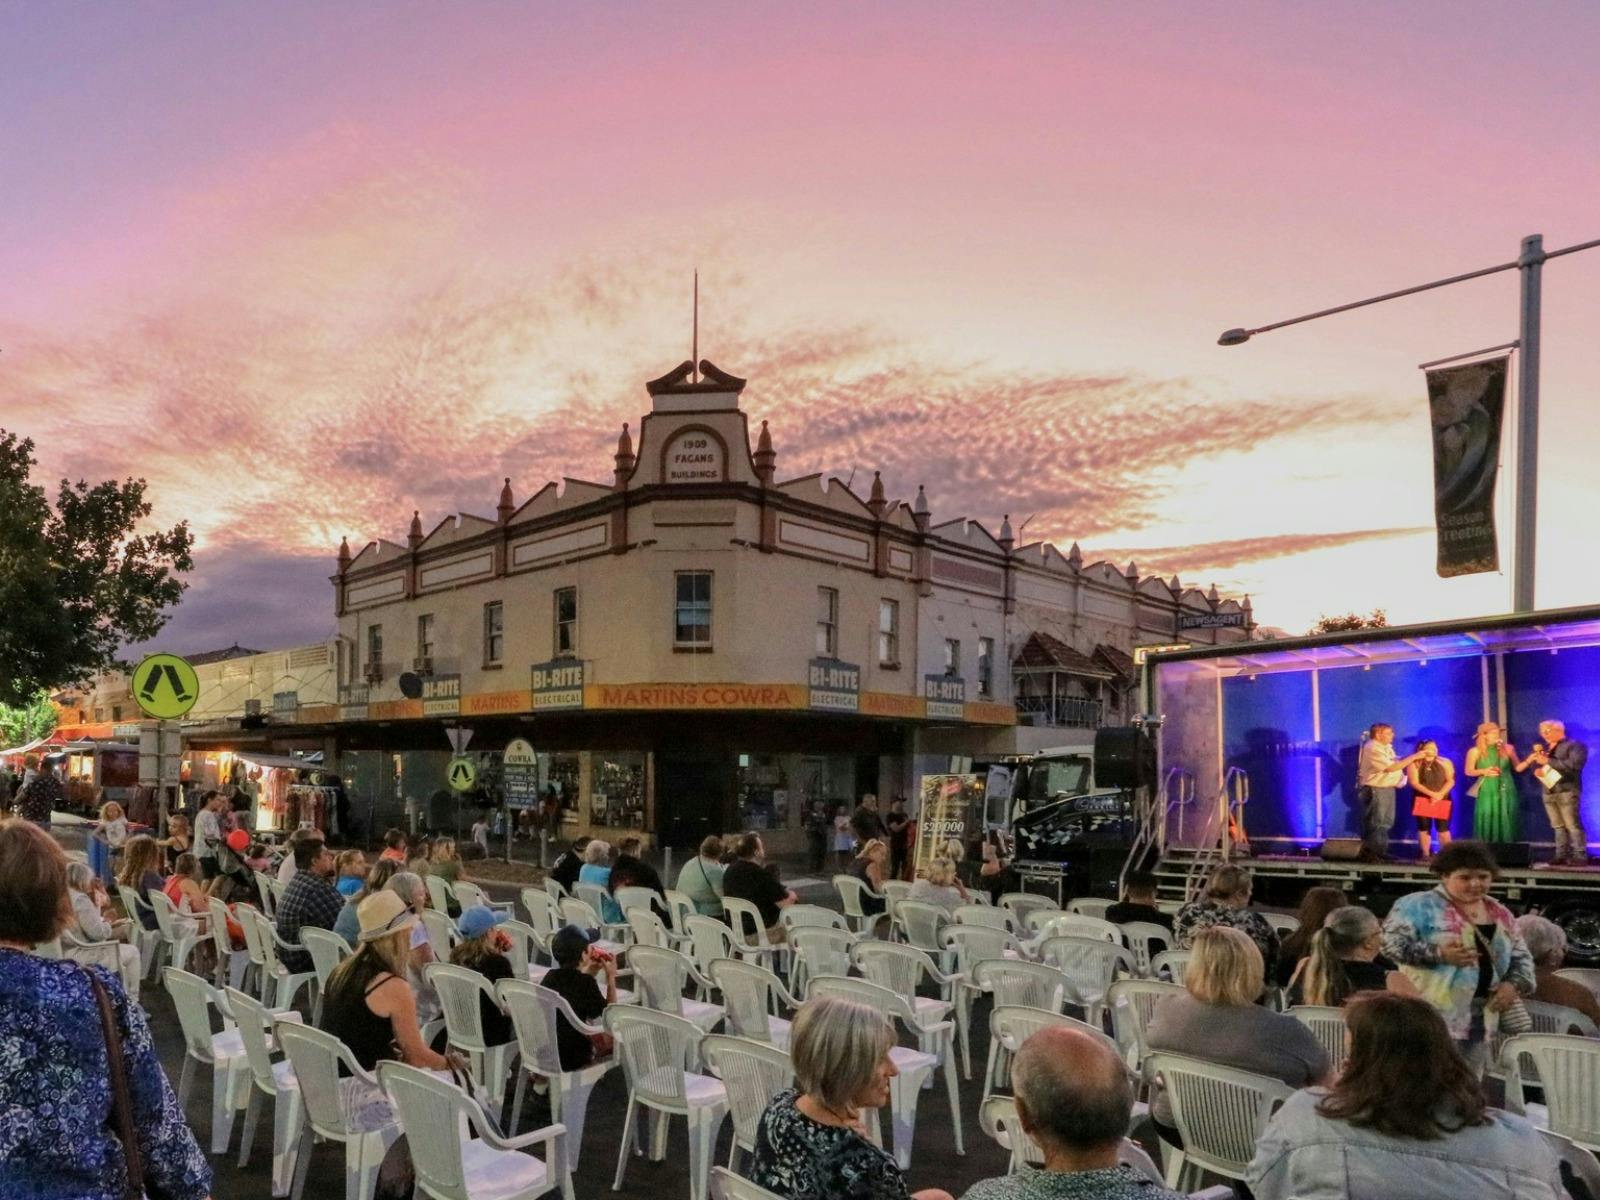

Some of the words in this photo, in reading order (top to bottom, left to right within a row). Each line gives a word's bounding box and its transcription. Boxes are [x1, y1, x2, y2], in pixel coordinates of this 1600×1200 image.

[684, 439, 707, 449] 1909
[671, 470, 718, 479] BUILDINGS
[1182, 614, 1243, 628] NEWSAGENT
[533, 666, 582, 690] BI-RITE
[810, 666, 859, 690] BI-RITE
[423, 679, 460, 698] BI-RITE
[926, 680, 964, 700] BI-RITE
[471, 694, 520, 713] MARTINS
[534, 693, 580, 706] ELECTRICAL
[602, 688, 698, 705] MARTINS
[701, 688, 792, 705] COWRA
[508, 754, 531, 762] COWRA
[922, 822, 964, 832] $20000
